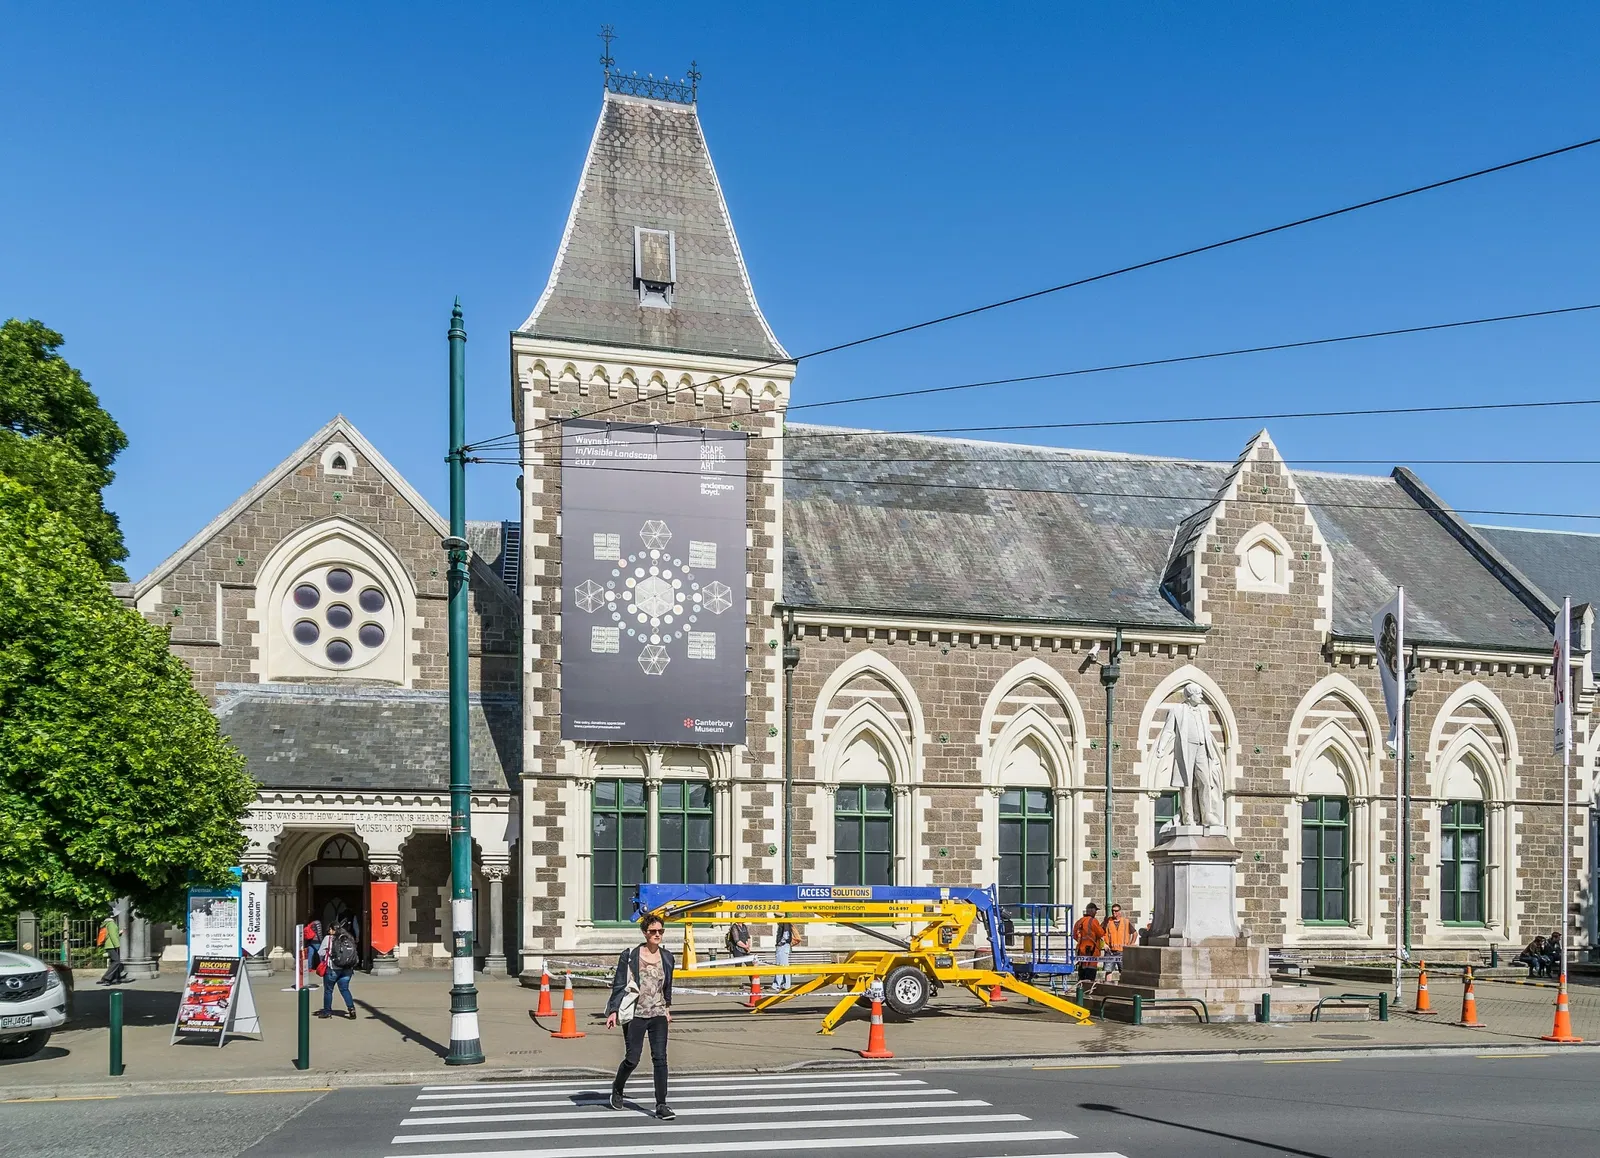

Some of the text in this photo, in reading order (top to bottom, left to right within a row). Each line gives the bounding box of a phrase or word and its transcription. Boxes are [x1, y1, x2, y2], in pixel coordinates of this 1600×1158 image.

[575, 447, 658, 460] In/Visible Landscape
[700, 445, 724, 454] SCAPE
[574, 458, 596, 466] 2017
[700, 462, 714, 470] ART
[694, 718, 734, 728] Canterbury
[258, 812, 272, 820] HIS
[276, 812, 296, 820] WAYS
[299, 812, 314, 820] BUT
[317, 812, 333, 820] HOW
[374, 814, 405, 822] PORTION
[417, 814, 439, 822] HEARD
[356, 824, 412, 832] MUSEUM 1870
[800, 888, 830, 896] ACCESS
[248, 892, 256, 933] Canterbury
[380, 902, 388, 928] open
